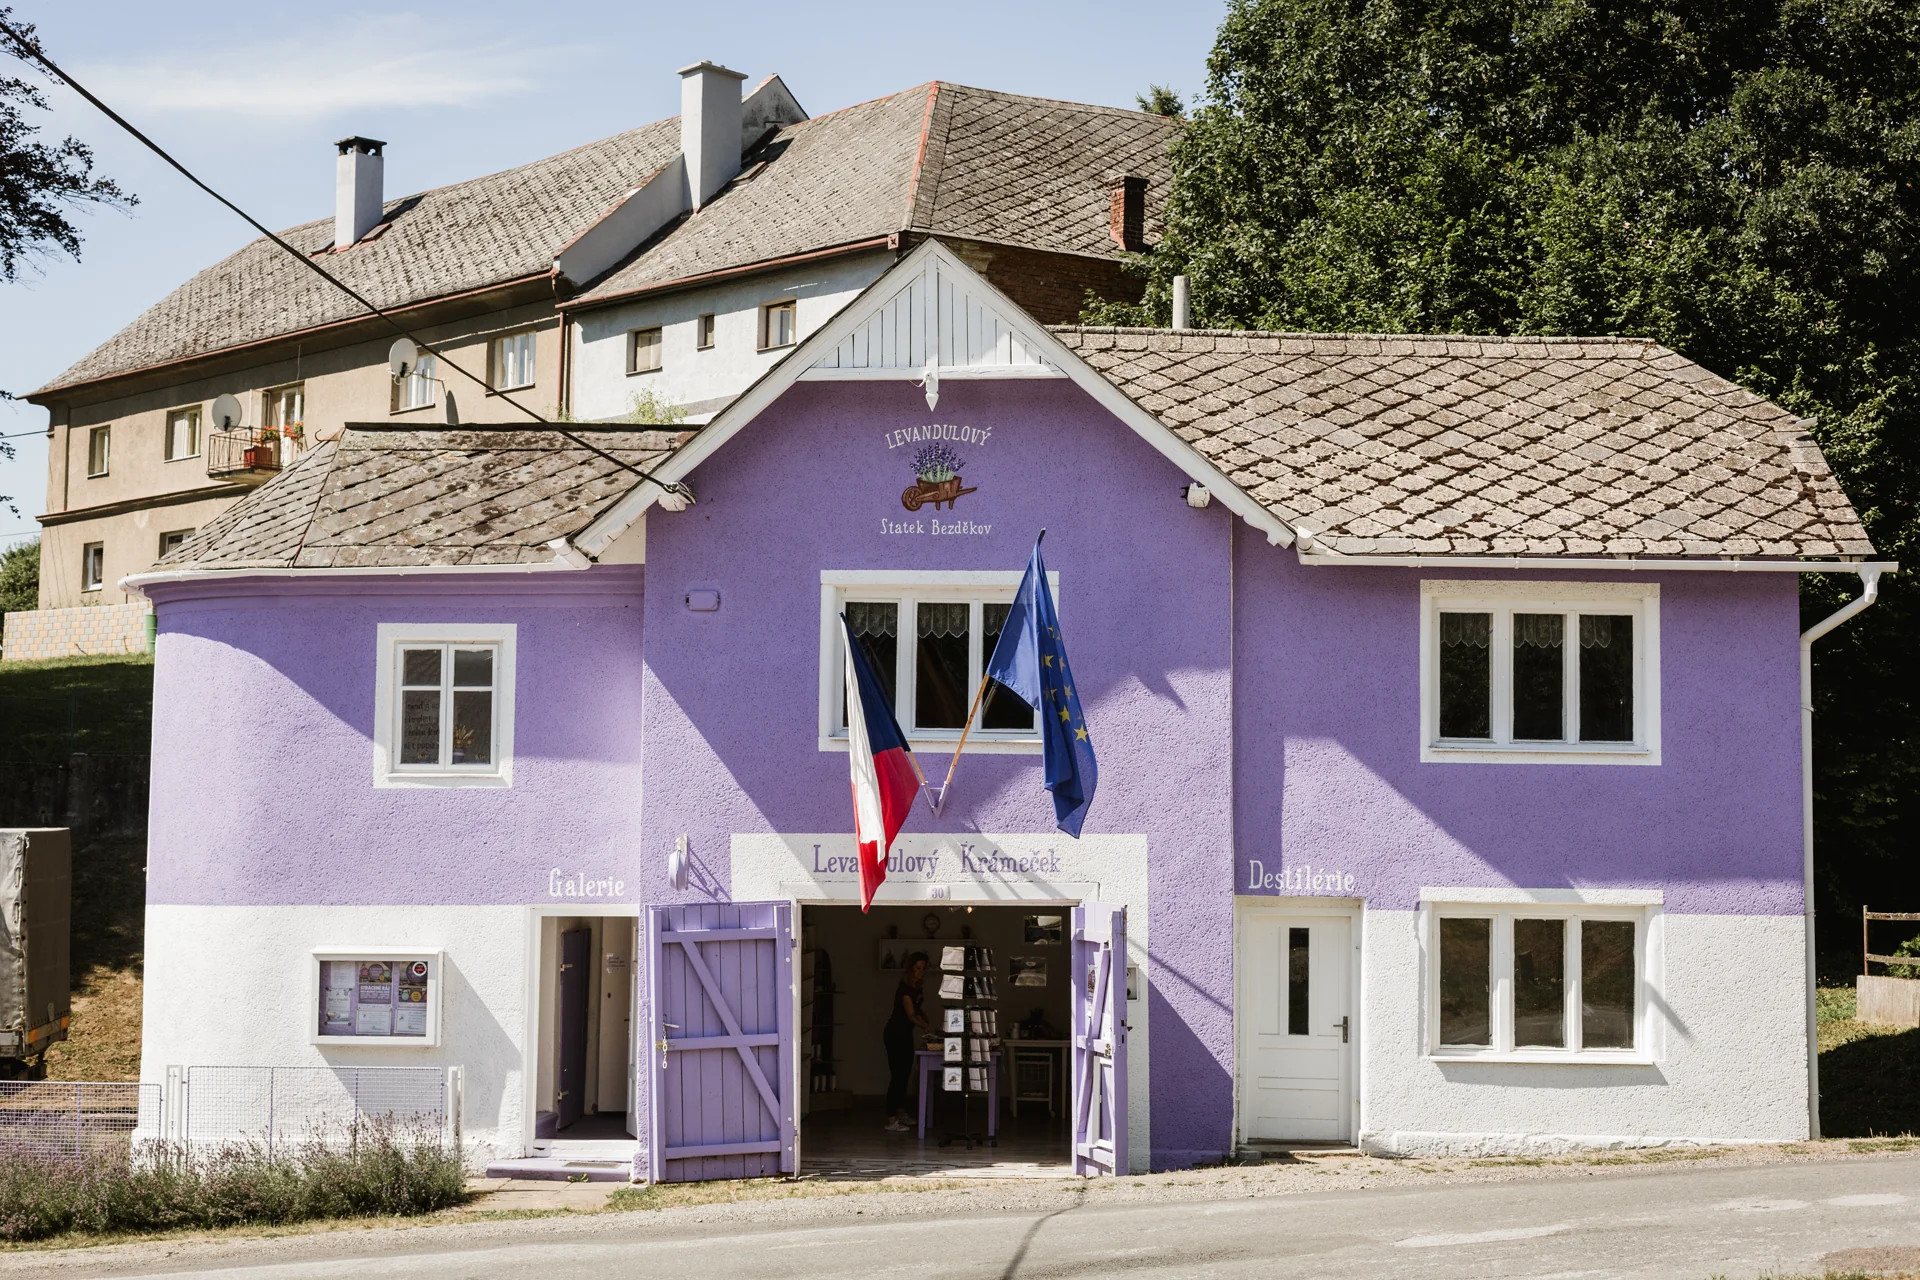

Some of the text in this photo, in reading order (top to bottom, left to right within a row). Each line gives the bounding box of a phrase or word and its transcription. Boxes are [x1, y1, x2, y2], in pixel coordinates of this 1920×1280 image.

[885, 424, 992, 449] LEVANDULOVÝ
[880, 518, 992, 535] Statek Bezděkov
[813, 843, 1060, 879] Levaulový Krámeček
[549, 867, 625, 897] Galerie
[1248, 860, 1356, 892] Destilérie
[931, 887, 944, 899] 30
